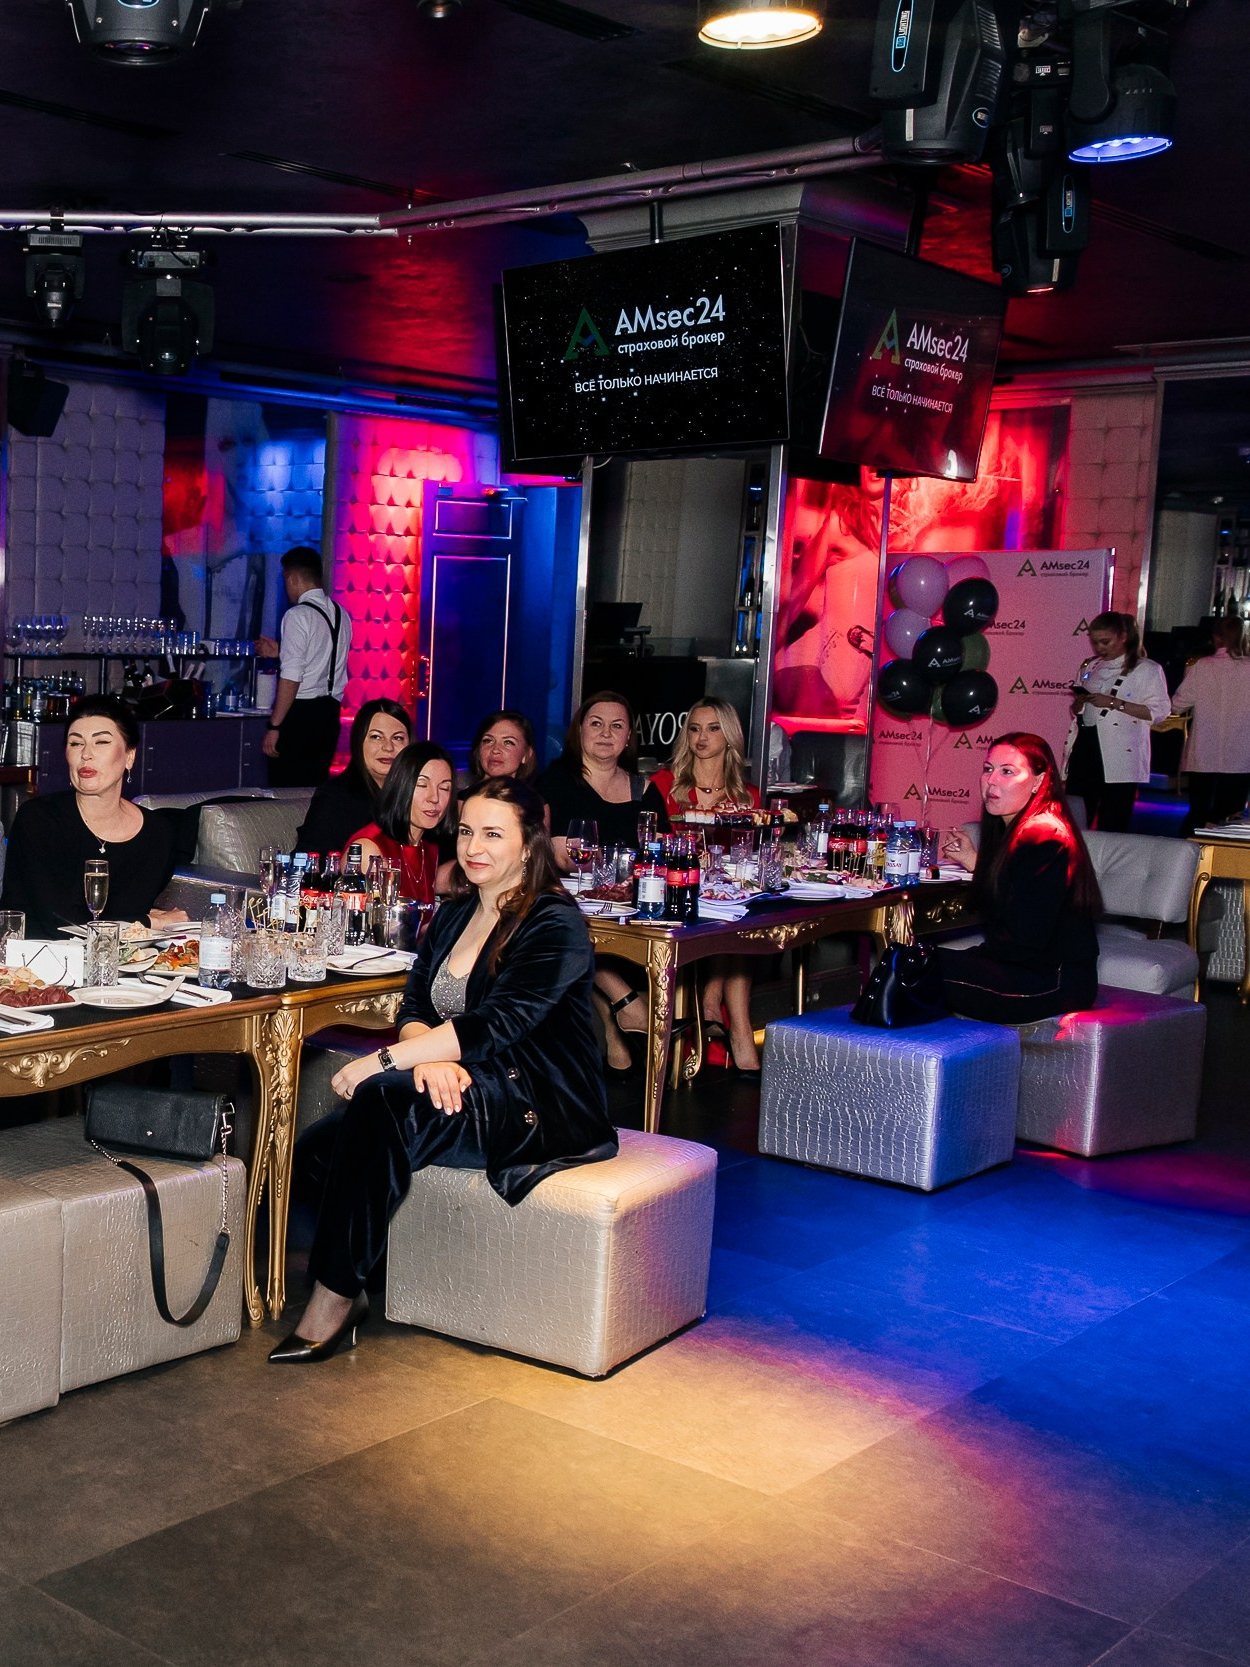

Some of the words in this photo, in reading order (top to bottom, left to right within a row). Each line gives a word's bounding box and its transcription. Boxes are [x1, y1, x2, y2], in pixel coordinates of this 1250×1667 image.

[614, 294, 726, 336] AMsec24
[617, 334, 679, 357] страховой
[681, 331, 725, 349] брокер
[906, 322, 970, 363] AMsec24
[575, 379, 596, 393] ВСЁ
[598, 376, 642, 391] ТОЛЬКО
[644, 367, 719, 386] НАЧИНАЕТСЯ
[904, 358, 939, 374] страховой
[939, 363, 963, 385] брокер
[871, 385, 886, 398] ВСЁ
[886, 388, 912, 404] ТОЛЬКО
[912, 395, 954, 414] НАЧИНАЕТСЯ
[1040, 560, 1090, 571] AMsec24
[1032, 680, 1075, 689] AMsec2
[878, 730, 923, 741] AMsec24
